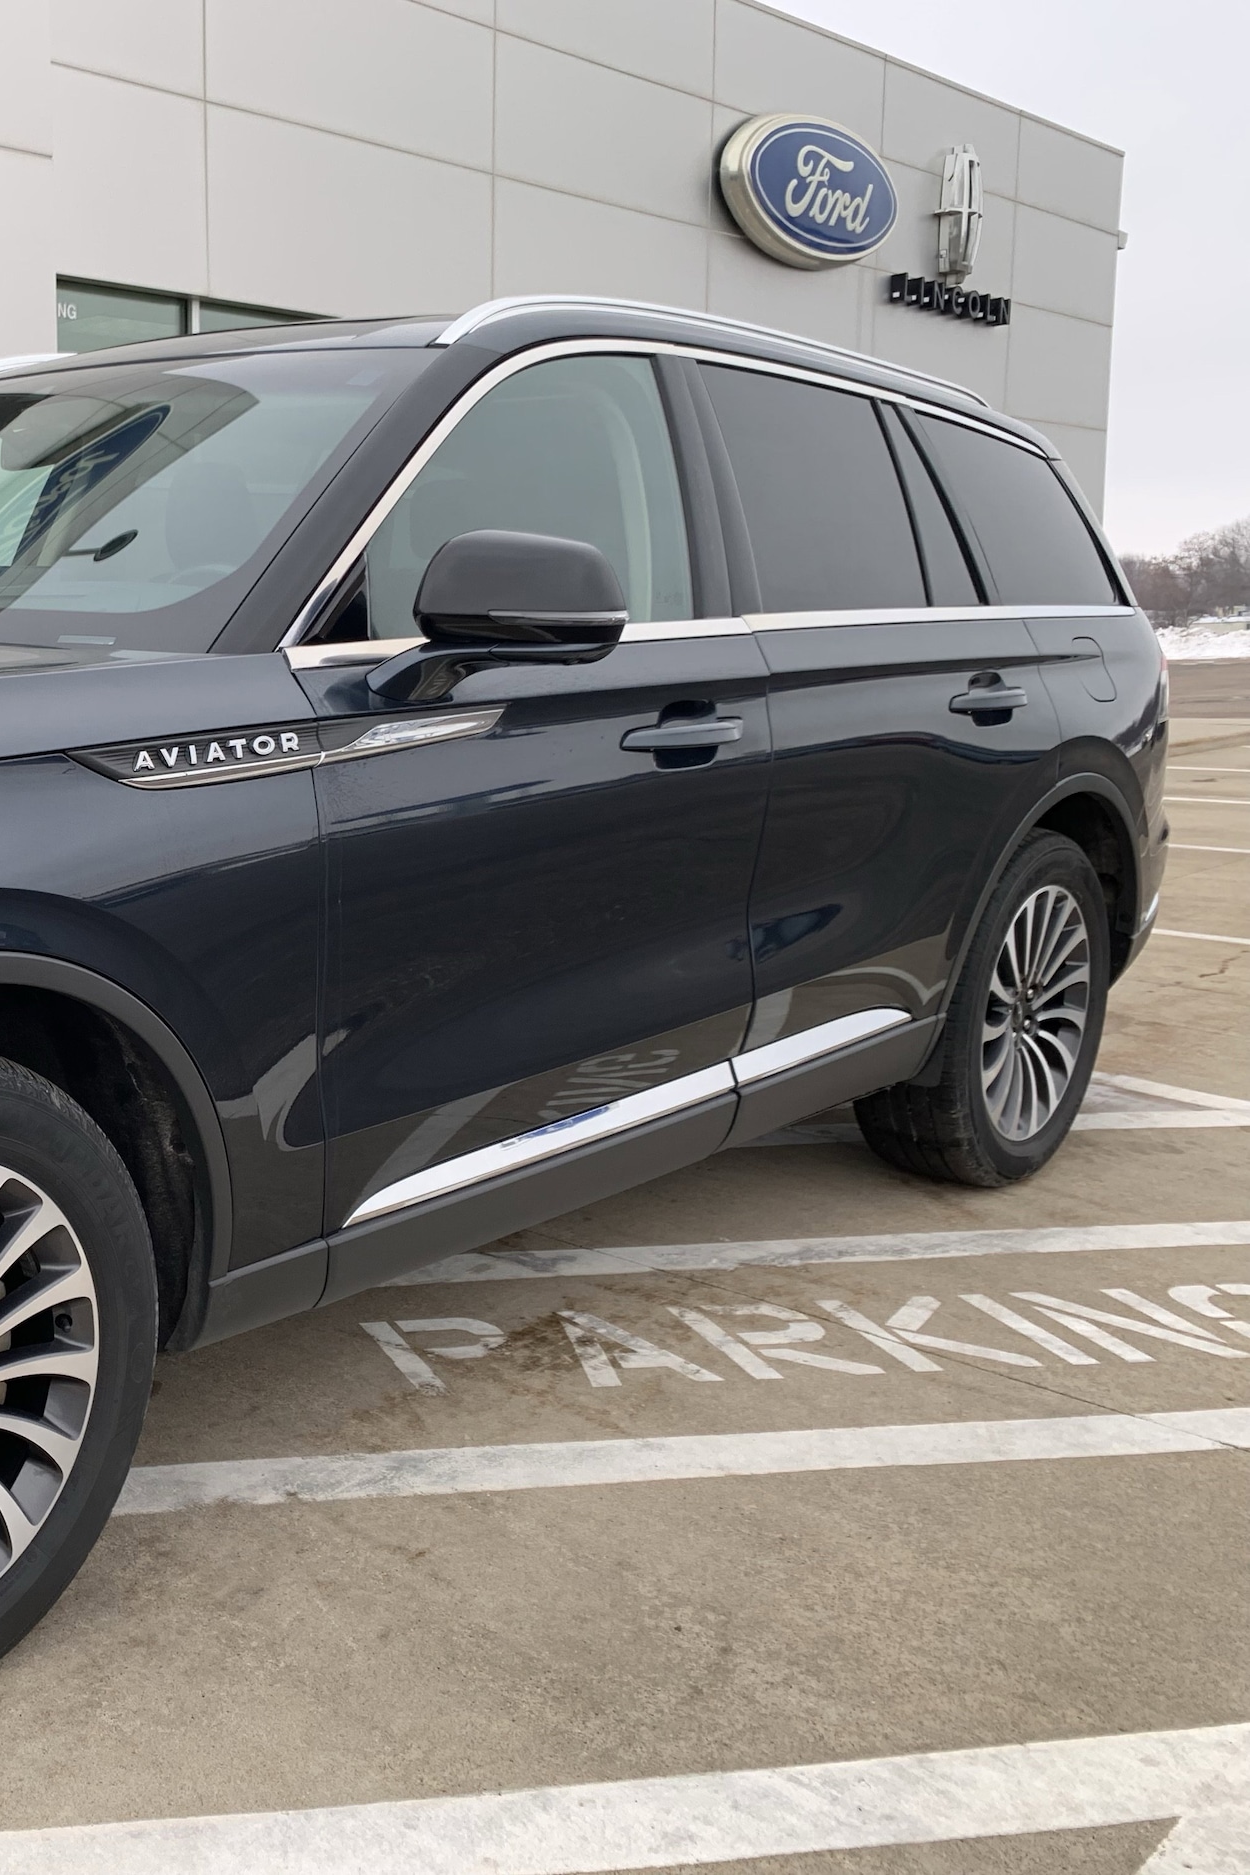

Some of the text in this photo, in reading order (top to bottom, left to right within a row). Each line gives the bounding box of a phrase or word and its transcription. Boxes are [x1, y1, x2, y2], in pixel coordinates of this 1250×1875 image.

[784, 145, 874, 234] Ford
[890, 272, 1011, 325] LINCOLN
[134, 731, 300, 772] AVIATOR
